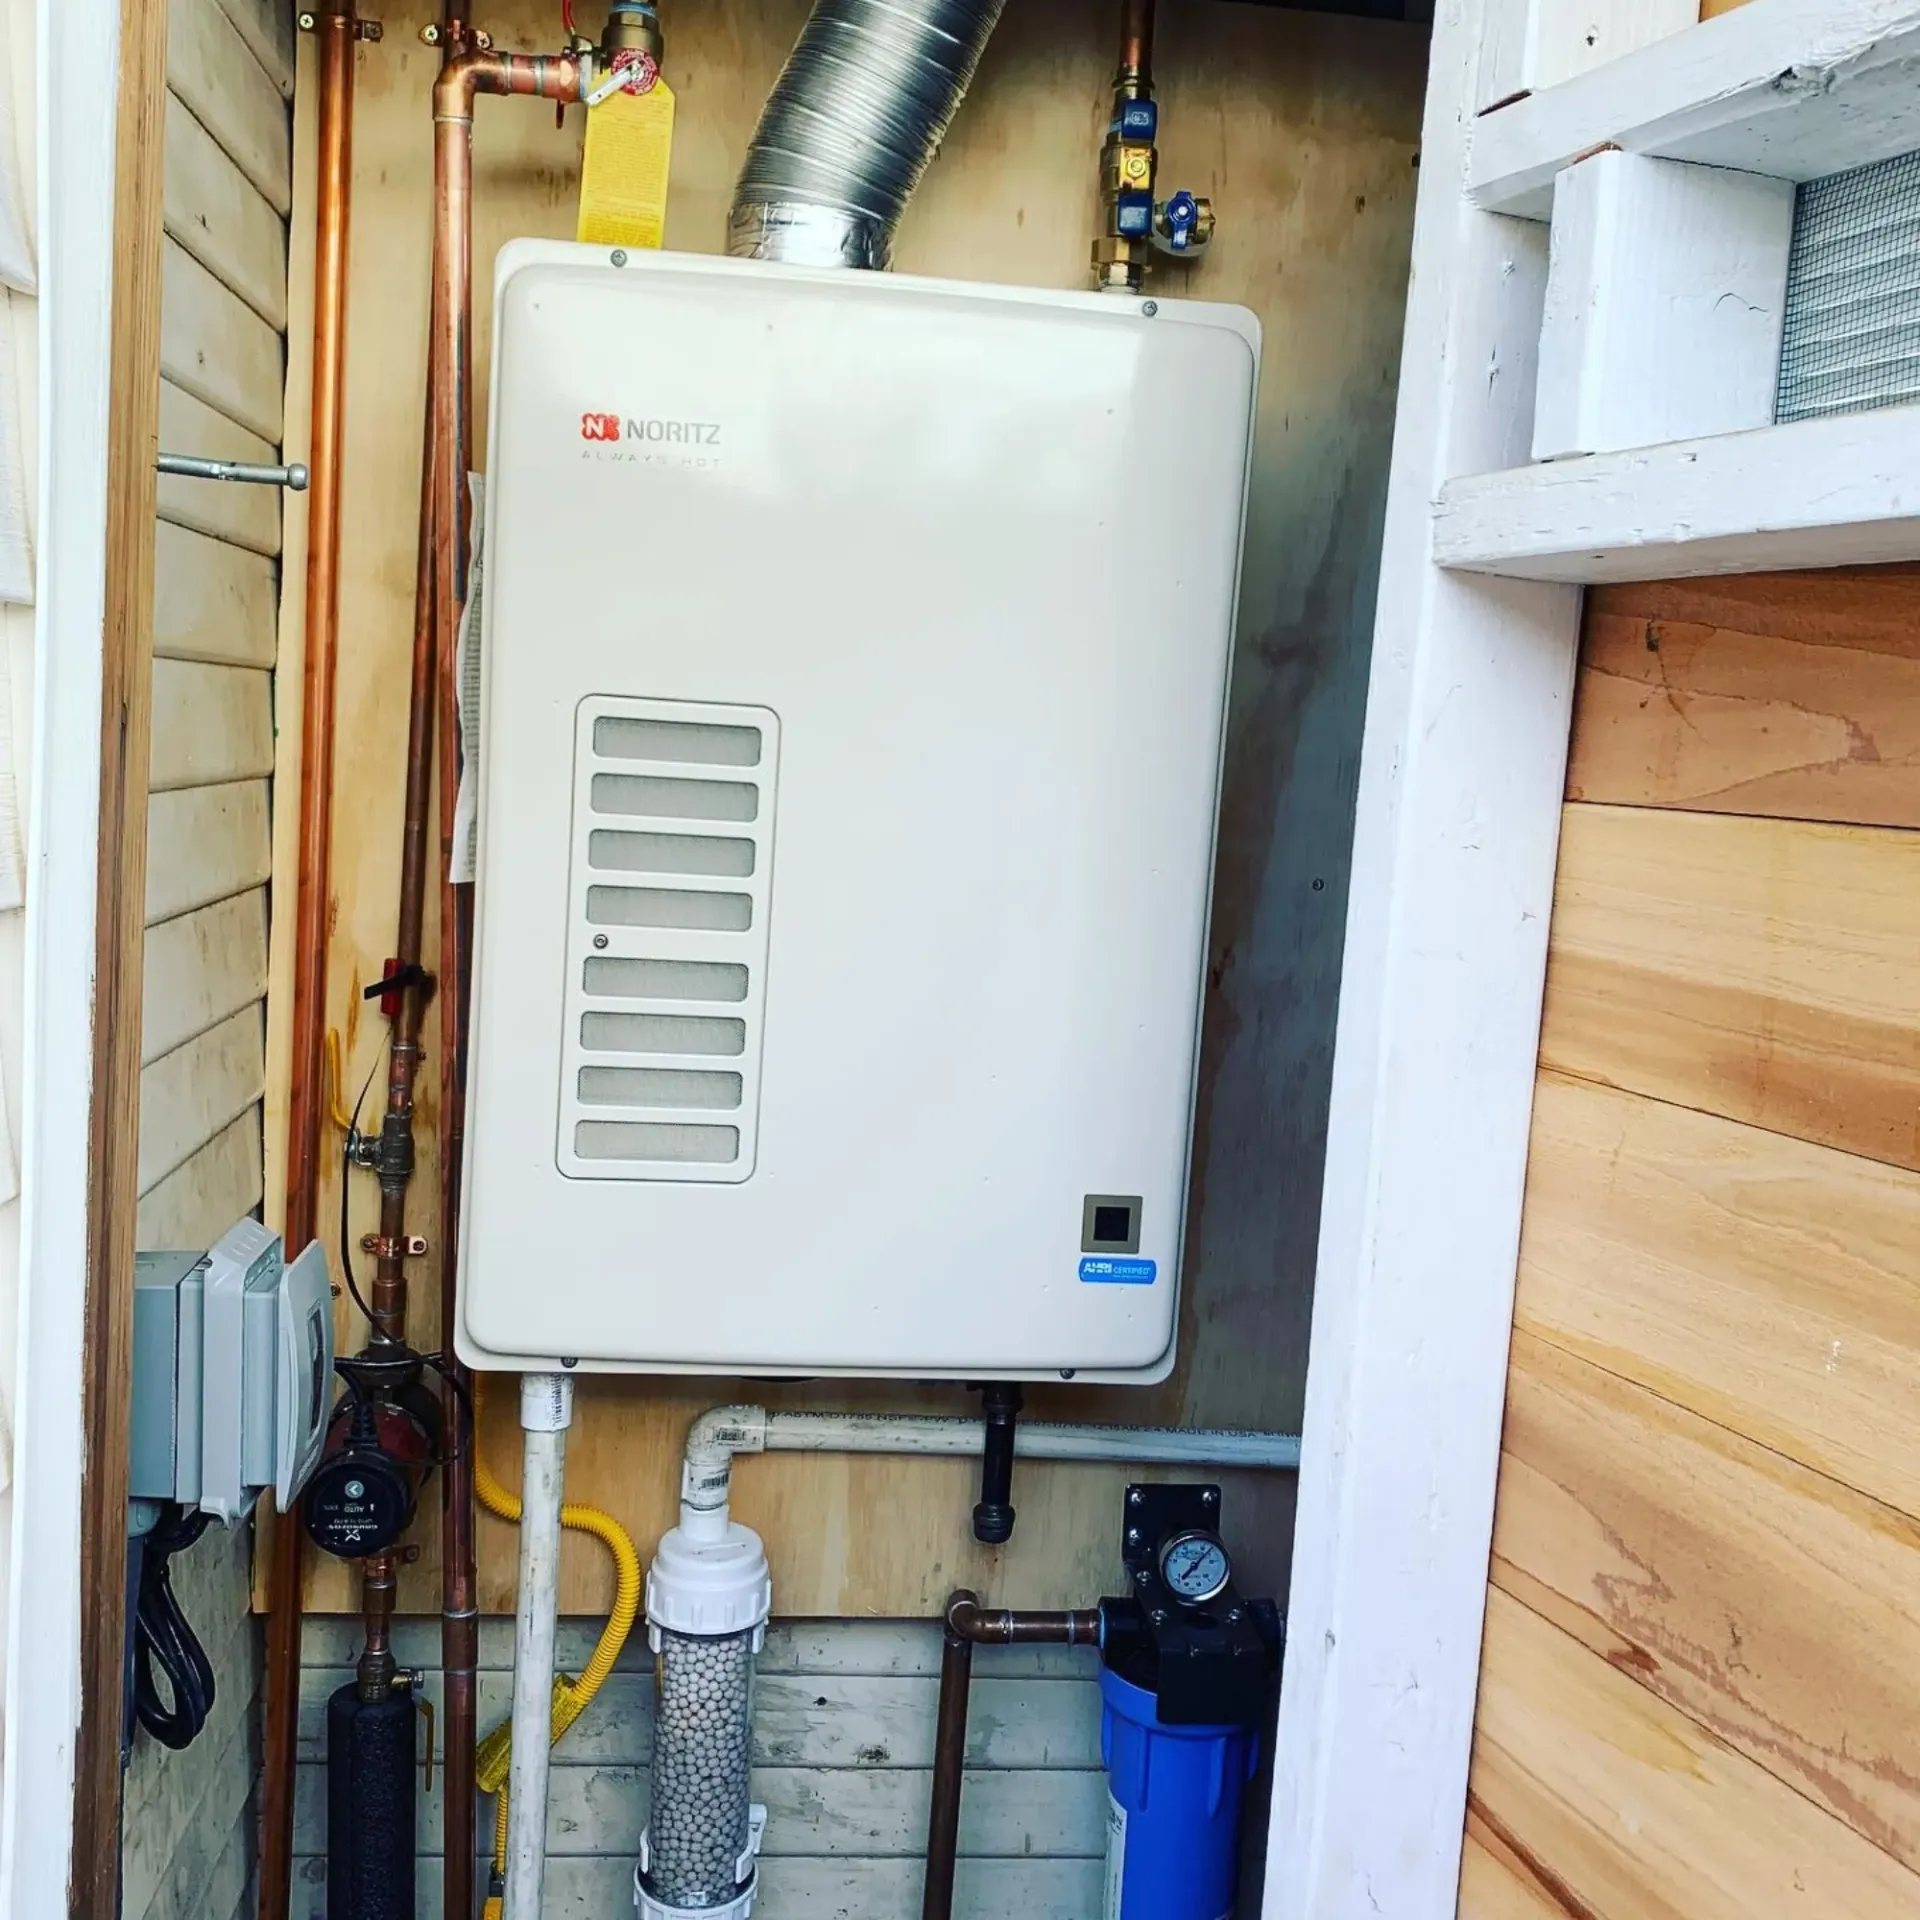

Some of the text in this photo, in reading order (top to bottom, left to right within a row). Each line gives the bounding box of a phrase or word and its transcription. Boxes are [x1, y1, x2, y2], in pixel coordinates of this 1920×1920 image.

[627, 418, 721, 445] NORITZ
[582, 450, 721, 468] ALWAYS HOT
